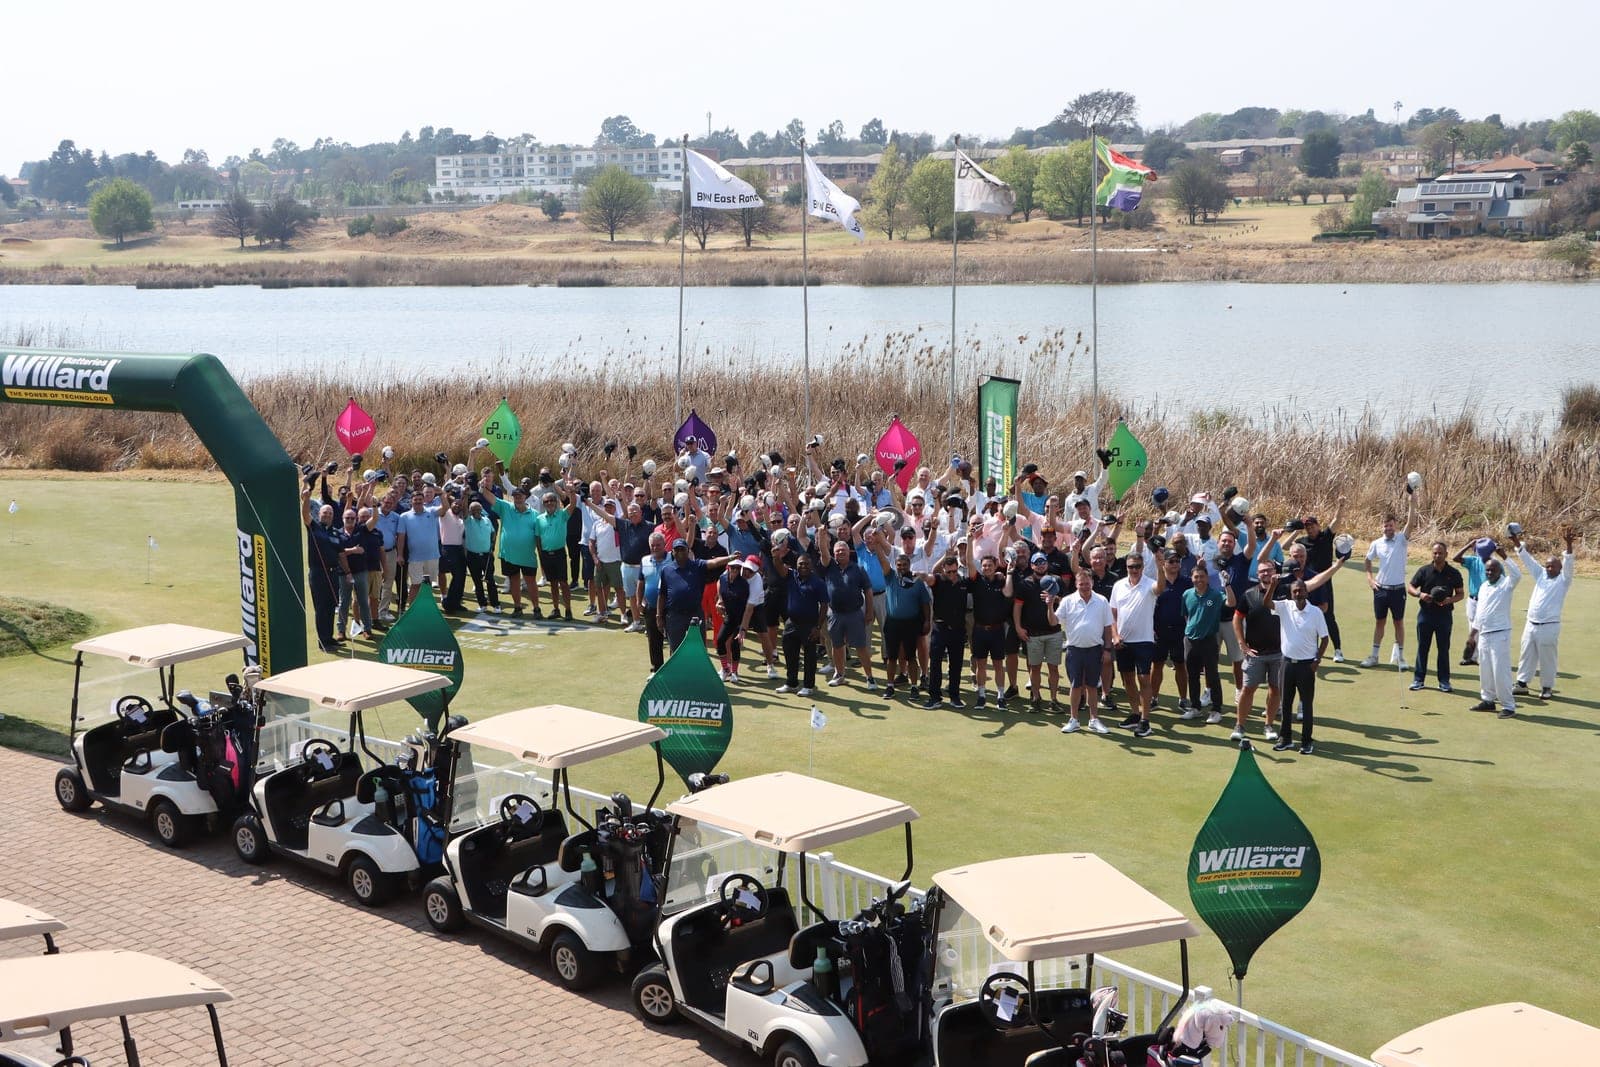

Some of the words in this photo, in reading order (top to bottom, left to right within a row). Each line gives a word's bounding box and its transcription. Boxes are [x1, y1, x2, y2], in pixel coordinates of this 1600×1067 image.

[714, 193, 737, 204] East
[2, 354, 118, 391] Willard
[61, 393, 108, 402] TECHNOLOGY
[351, 426, 371, 437] VUMA
[496, 433, 513, 441] DFA
[256, 541, 266, 603] TECHNOLOGY
[260, 607, 266, 619] OF
[260, 621, 268, 654] POWER
[386, 648, 455, 665] Willard
[647, 700, 724, 719] Willard
[1198, 846, 1306, 873] Willard
